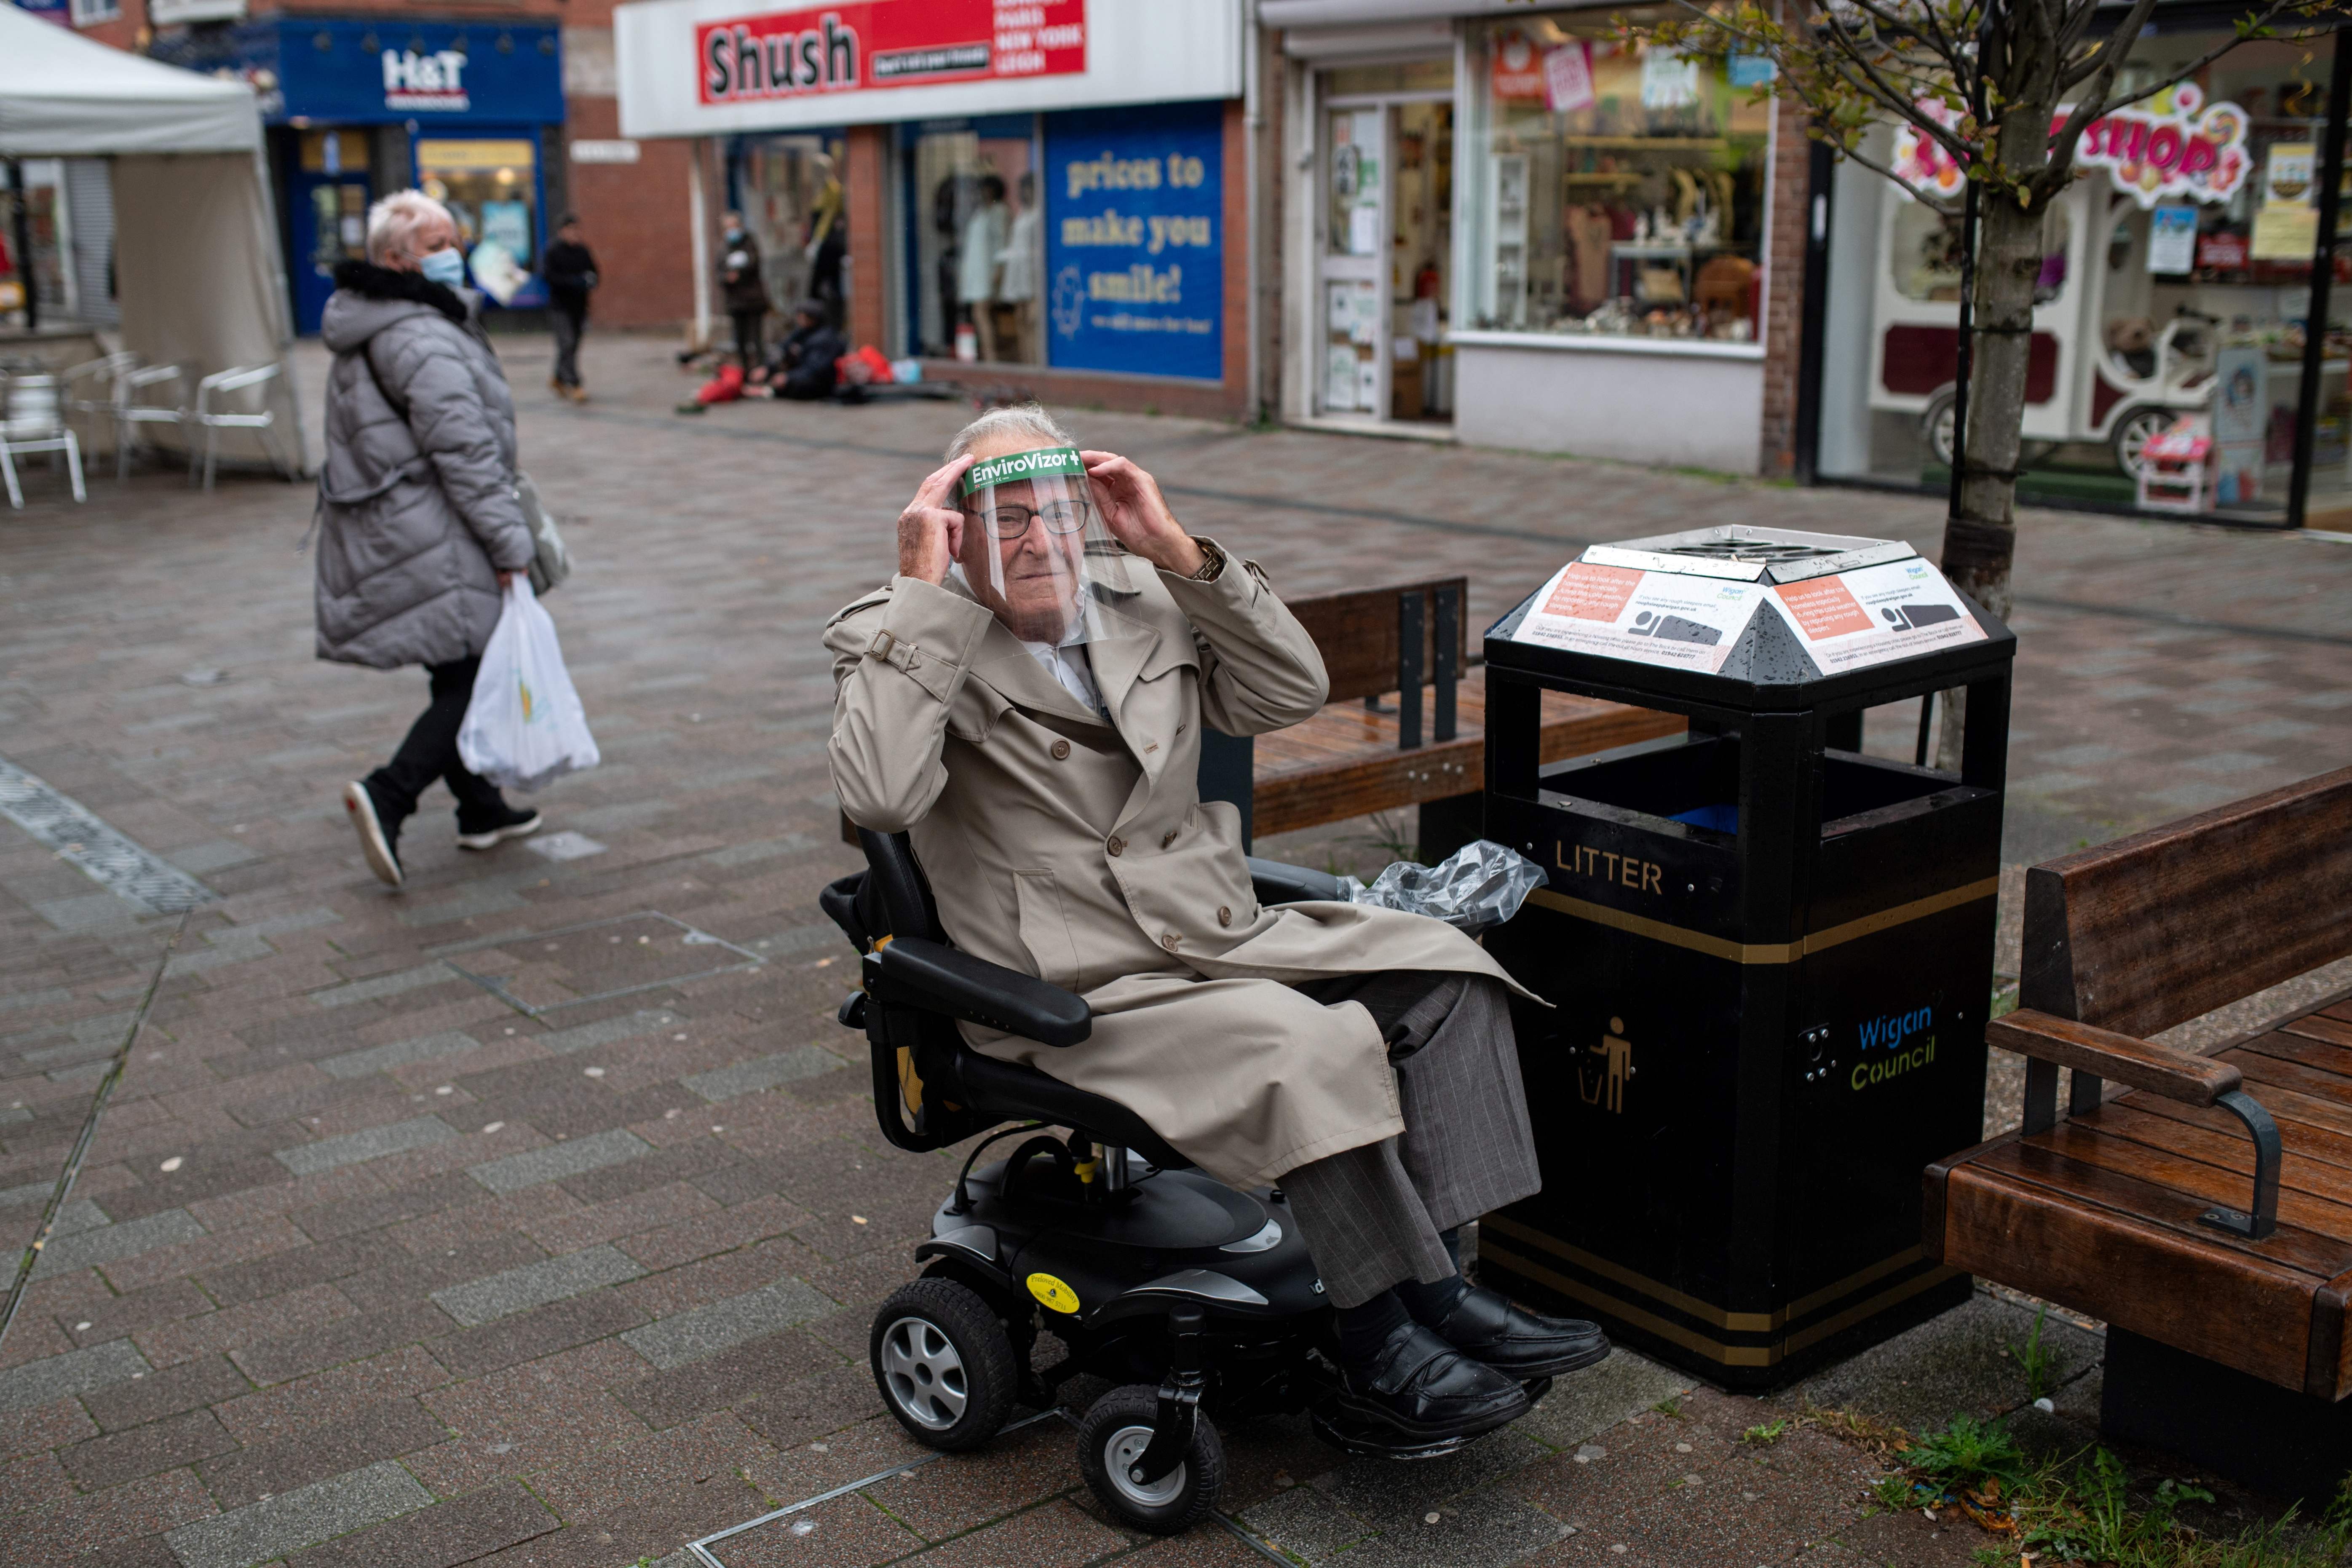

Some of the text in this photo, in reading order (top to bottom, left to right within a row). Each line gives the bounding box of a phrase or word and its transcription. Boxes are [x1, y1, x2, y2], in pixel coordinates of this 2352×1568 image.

[995, 24, 1083, 50] NEW YORK
[705, 14, 860, 99] Shush
[382, 48, 468, 91] H&T
[2086, 116, 2218, 172] SHOP
[1066, 150, 1205, 199] prices to
[1061, 208, 1211, 255] make you
[1088, 263, 1182, 304] smile!
[972, 452, 1067, 484] EnviroVizor
[1563, 581, 1618, 593] homeless especially
[1909, 572, 1928, 580] Council
[1562, 597, 1587, 605] reporting
[1603, 593, 1627, 601] weather
[1717, 593, 1743, 601] Council
[1722, 586, 1743, 595] Wigan
[1816, 596, 1841, 607] especially
[1635, 600, 1696, 611] roughsleep@wigan.gov.uk
[1797, 609, 1815, 618] during
[1837, 602, 1856, 610] weather
[1811, 615, 1834, 625] reporting
[1844, 610, 1860, 618] rough
[1808, 625, 1831, 634] sleepers.
[1557, 840, 1662, 895] LITTER
[1859, 1005, 1932, 1051] Wigan
[1852, 1035, 1935, 1091] Council
[1031, 1275, 1078, 1303] Preloved Mobility
[1034, 1290, 1045, 1300] 0800
[1055, 1301, 1066, 1310] 5711
